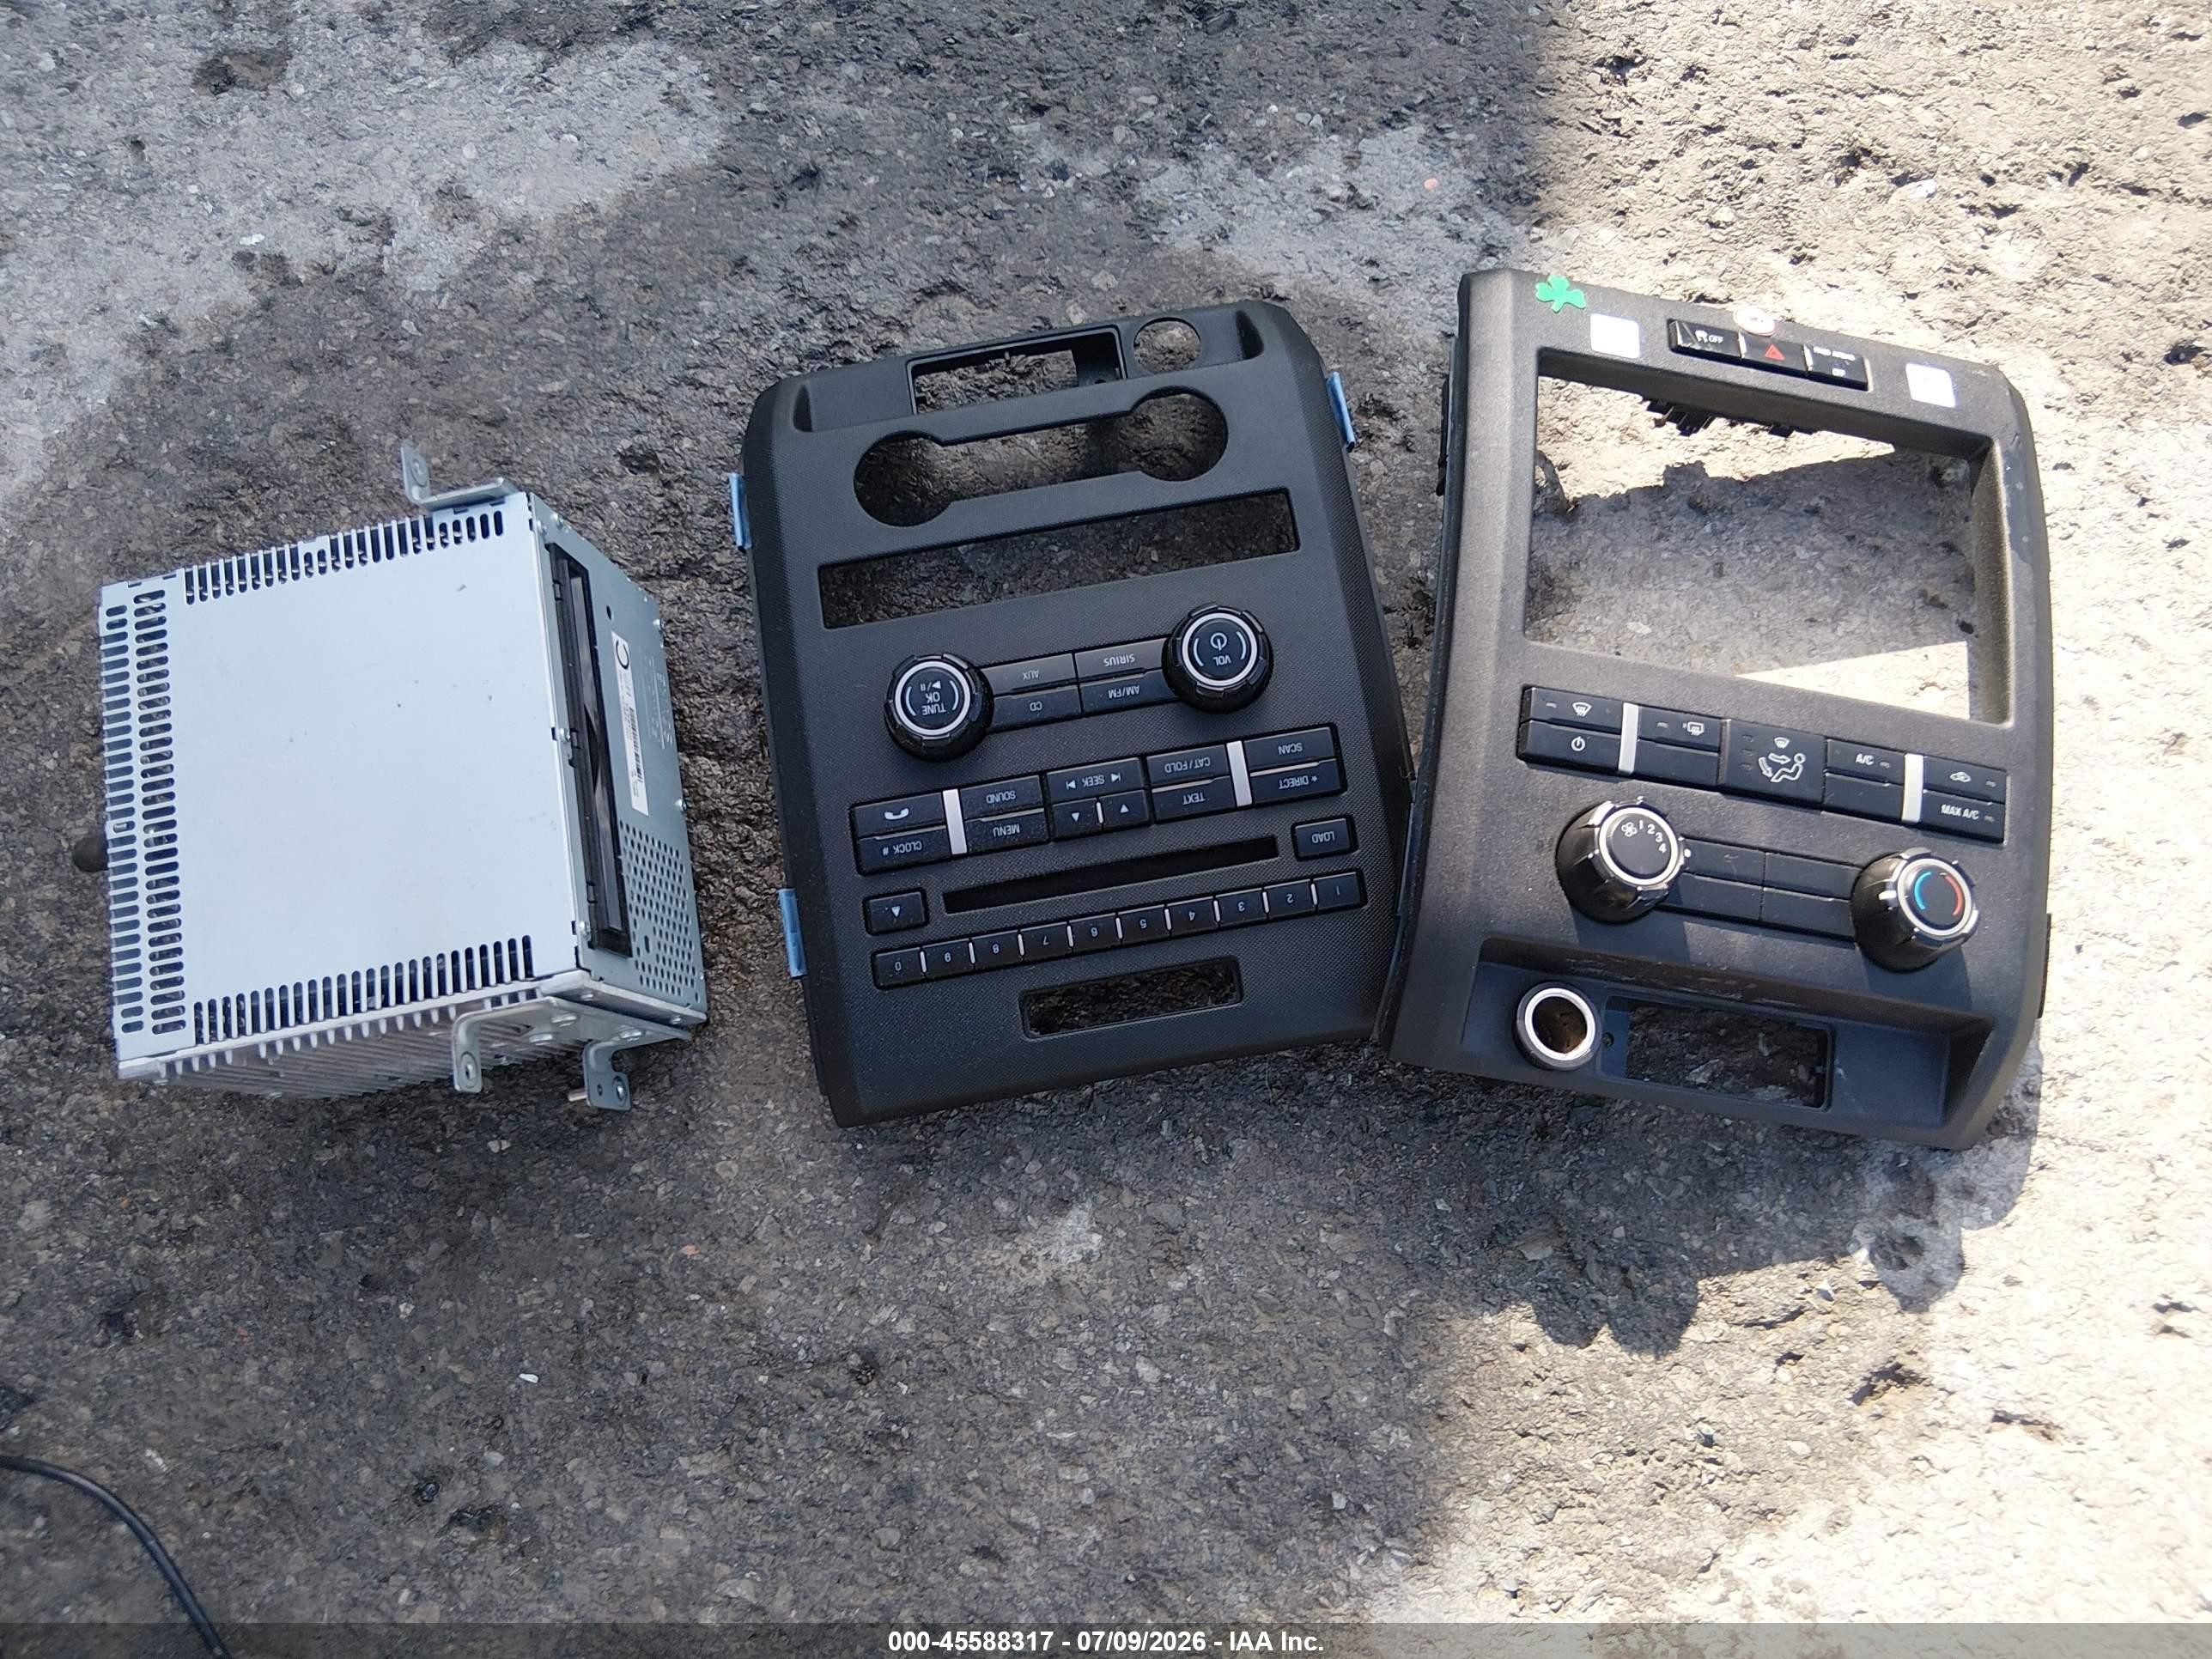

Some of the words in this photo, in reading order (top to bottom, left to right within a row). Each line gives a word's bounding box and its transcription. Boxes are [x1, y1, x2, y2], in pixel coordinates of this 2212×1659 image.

[1103, 653, 1136, 667] SIRIUS
[1212, 654, 1232, 666] VOL
[1023, 669, 1039, 681] AUX
[925, 691, 941, 704] OK
[1108, 684, 1140, 699] AM/FM
[921, 703, 947, 716] TUNE
[1030, 701, 1043, 712] CD
[1278, 742, 1303, 755] SCAN
[1164, 757, 1211, 773] CAT/FOLD
[1855, 753, 1875, 766] A/C
[1082, 775, 1105, 787] SEEK
[1278, 775, 1310, 790] DIRECT
[986, 790, 1017, 804] SOUND
[1182, 792, 1206, 805] TEXT
[1941, 804, 1961, 817] MAX
[1962, 808, 1980, 821] A/C
[993, 823, 1020, 838] MENU
[1639, 819, 1644, 830] 1
[1647, 823, 1656, 835] 2
[1311, 830, 1335, 843] LOAD
[1655, 831, 1663, 842] 3
[882, 847, 889, 856] #
[893, 840, 923, 854] CLOCK
[1658, 842, 1667, 854] 4
[1335, 885, 1340, 896] 1
[1286, 893, 1294, 903] 2
[1237, 901, 1245, 912] 3
[1188, 910, 1195, 921] 4
[1139, 918, 1147, 929] 5
[1091, 927, 1098, 938] 6
[1042, 935, 1049, 945] 7
[993, 944, 1000, 954] 8
[945, 951, 951, 963] 9
[894, 961, 902, 972] 0
